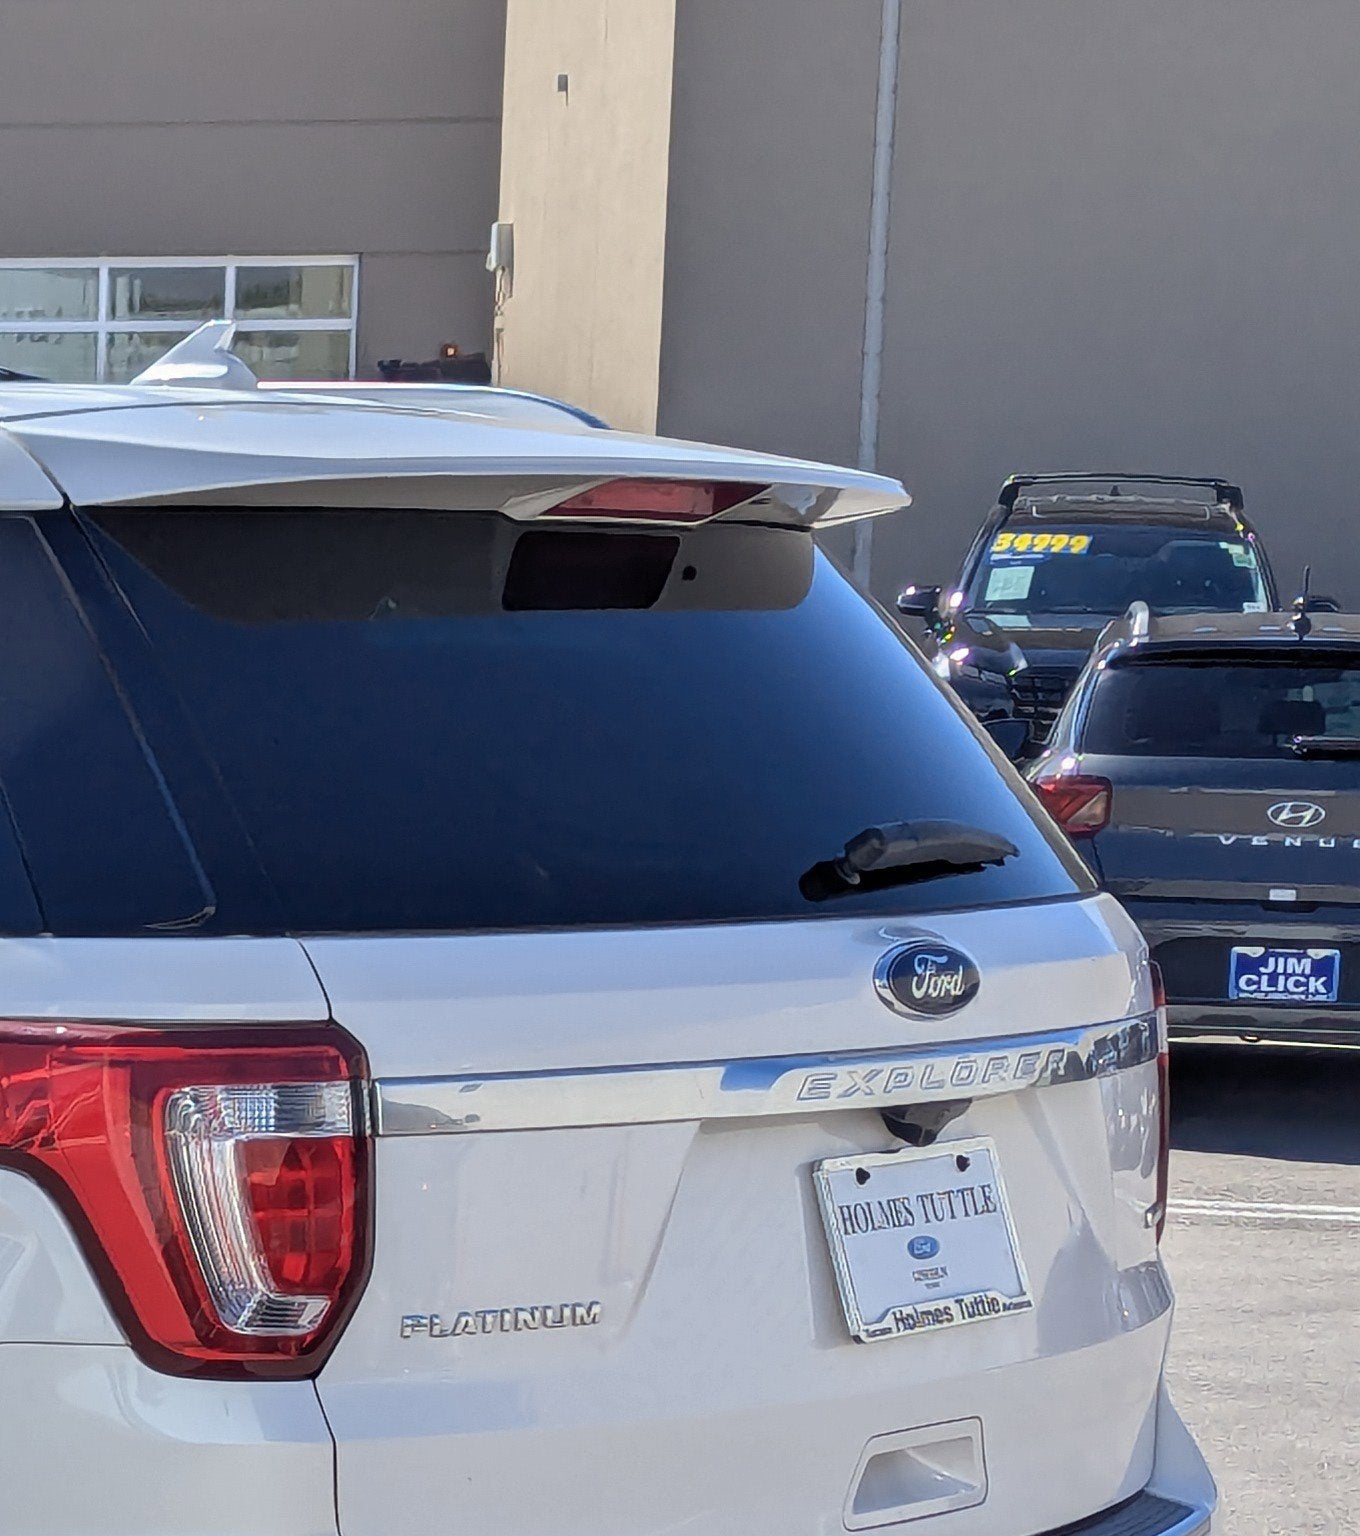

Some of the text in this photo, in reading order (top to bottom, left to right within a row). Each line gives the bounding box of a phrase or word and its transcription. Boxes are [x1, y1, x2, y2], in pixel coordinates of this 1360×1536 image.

[912, 954, 965, 999] Ford
[1238, 974, 1328, 994] CLICK
[1259, 956, 1312, 975] JIM
[796, 1048, 1067, 1101] EXPLORER
[838, 1183, 997, 1236] HOLMES TUTTLE
[400, 1300, 601, 1339] PLATINUM
[892, 1305, 954, 1333] Holmes
